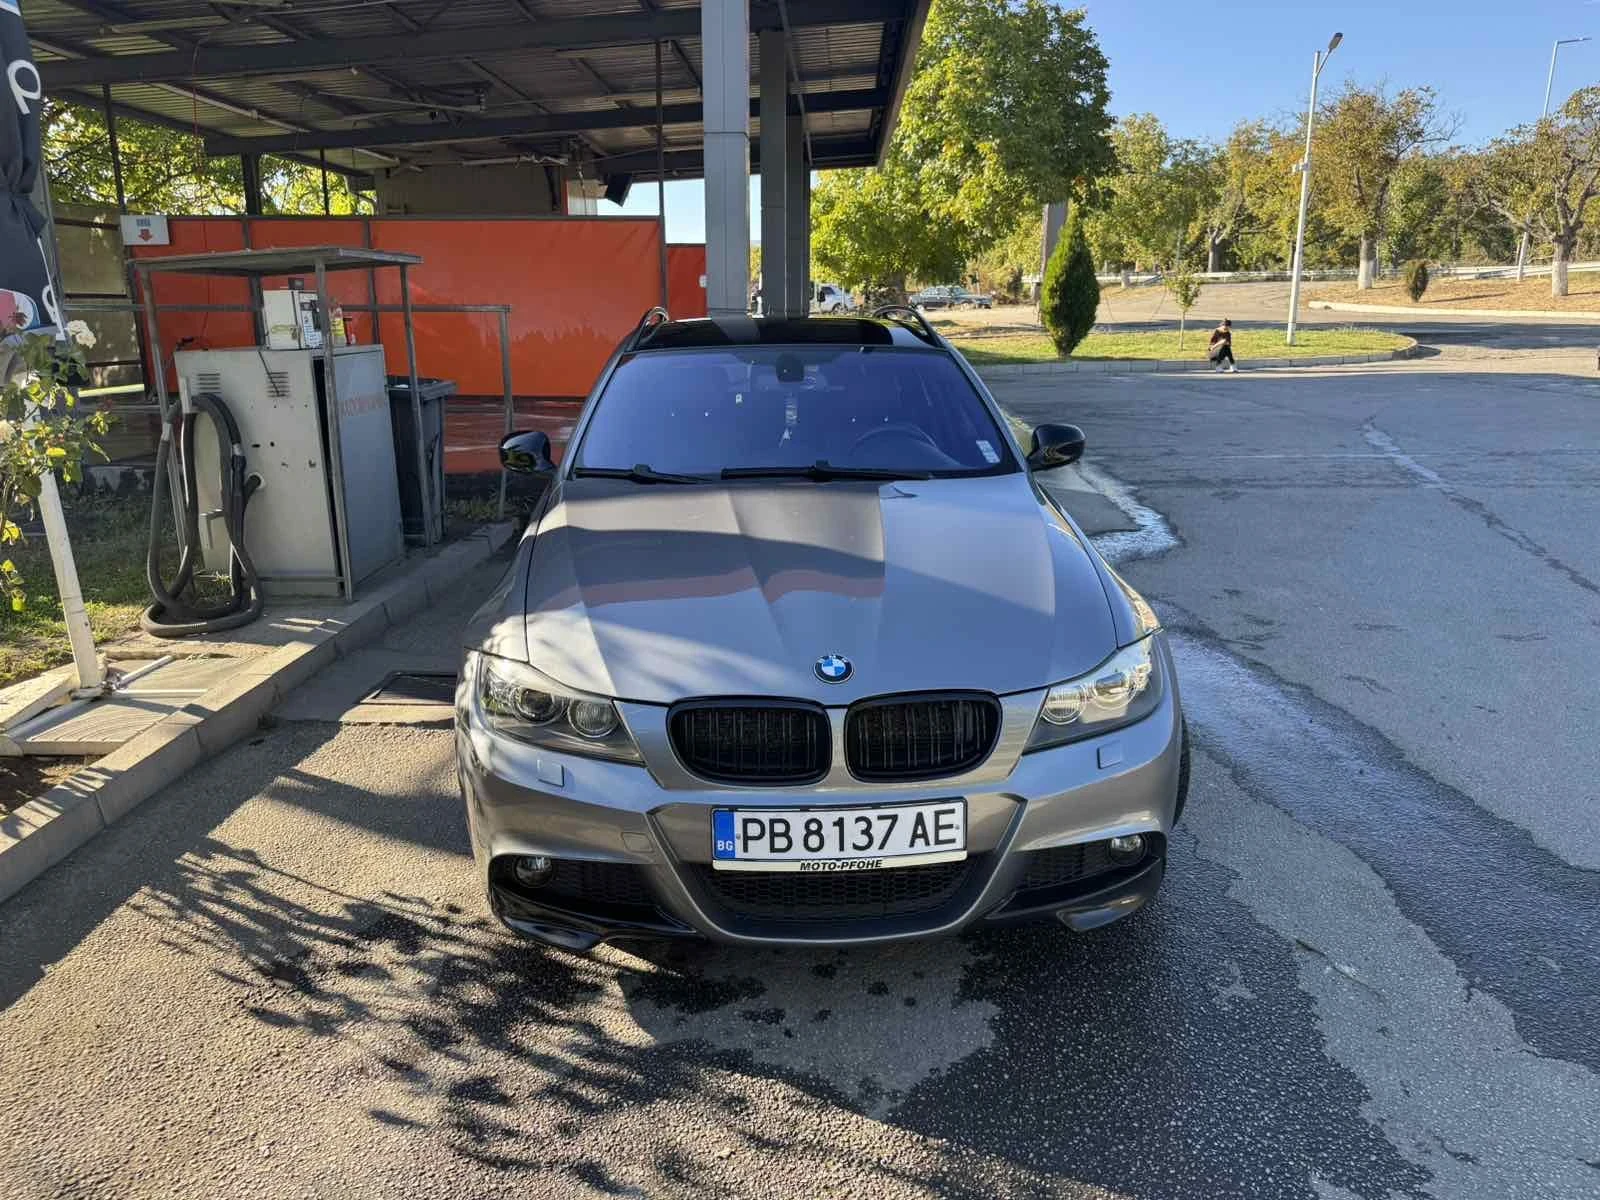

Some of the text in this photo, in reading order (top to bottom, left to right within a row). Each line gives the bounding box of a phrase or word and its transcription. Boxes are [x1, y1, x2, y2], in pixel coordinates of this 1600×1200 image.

[742, 808, 956, 853] PB 8137 AE
[717, 840, 734, 851] BG
